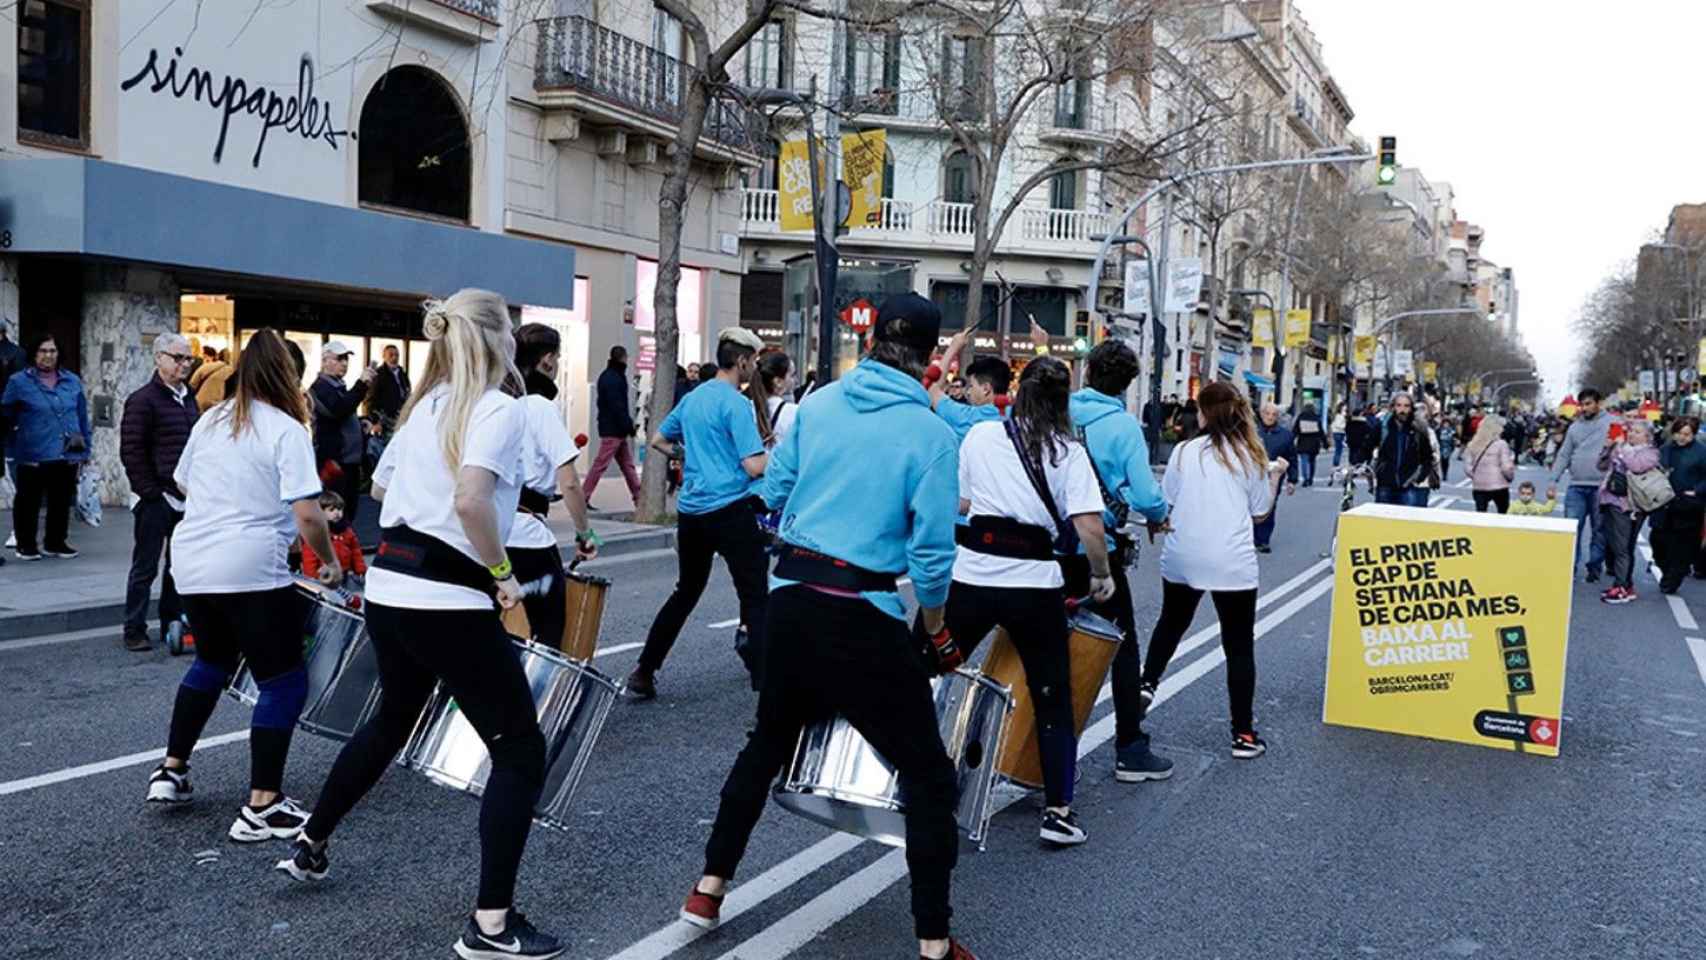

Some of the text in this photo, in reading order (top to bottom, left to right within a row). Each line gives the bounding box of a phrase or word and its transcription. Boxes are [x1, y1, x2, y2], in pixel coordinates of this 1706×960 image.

[852, 308, 871, 325] M
[1350, 537, 1473, 567] EL PRIMER
[1353, 561, 1438, 586] CAP DE
[1355, 579, 1475, 607] SETMANA
[1359, 595, 1527, 626] DE CADA MES,
[1362, 620, 1473, 646] BAIXA AL
[1365, 641, 1470, 667] CARRER!
[1370, 681, 1449, 695] OBRIMCARRERS
[1483, 722, 1525, 735] Barcelona
